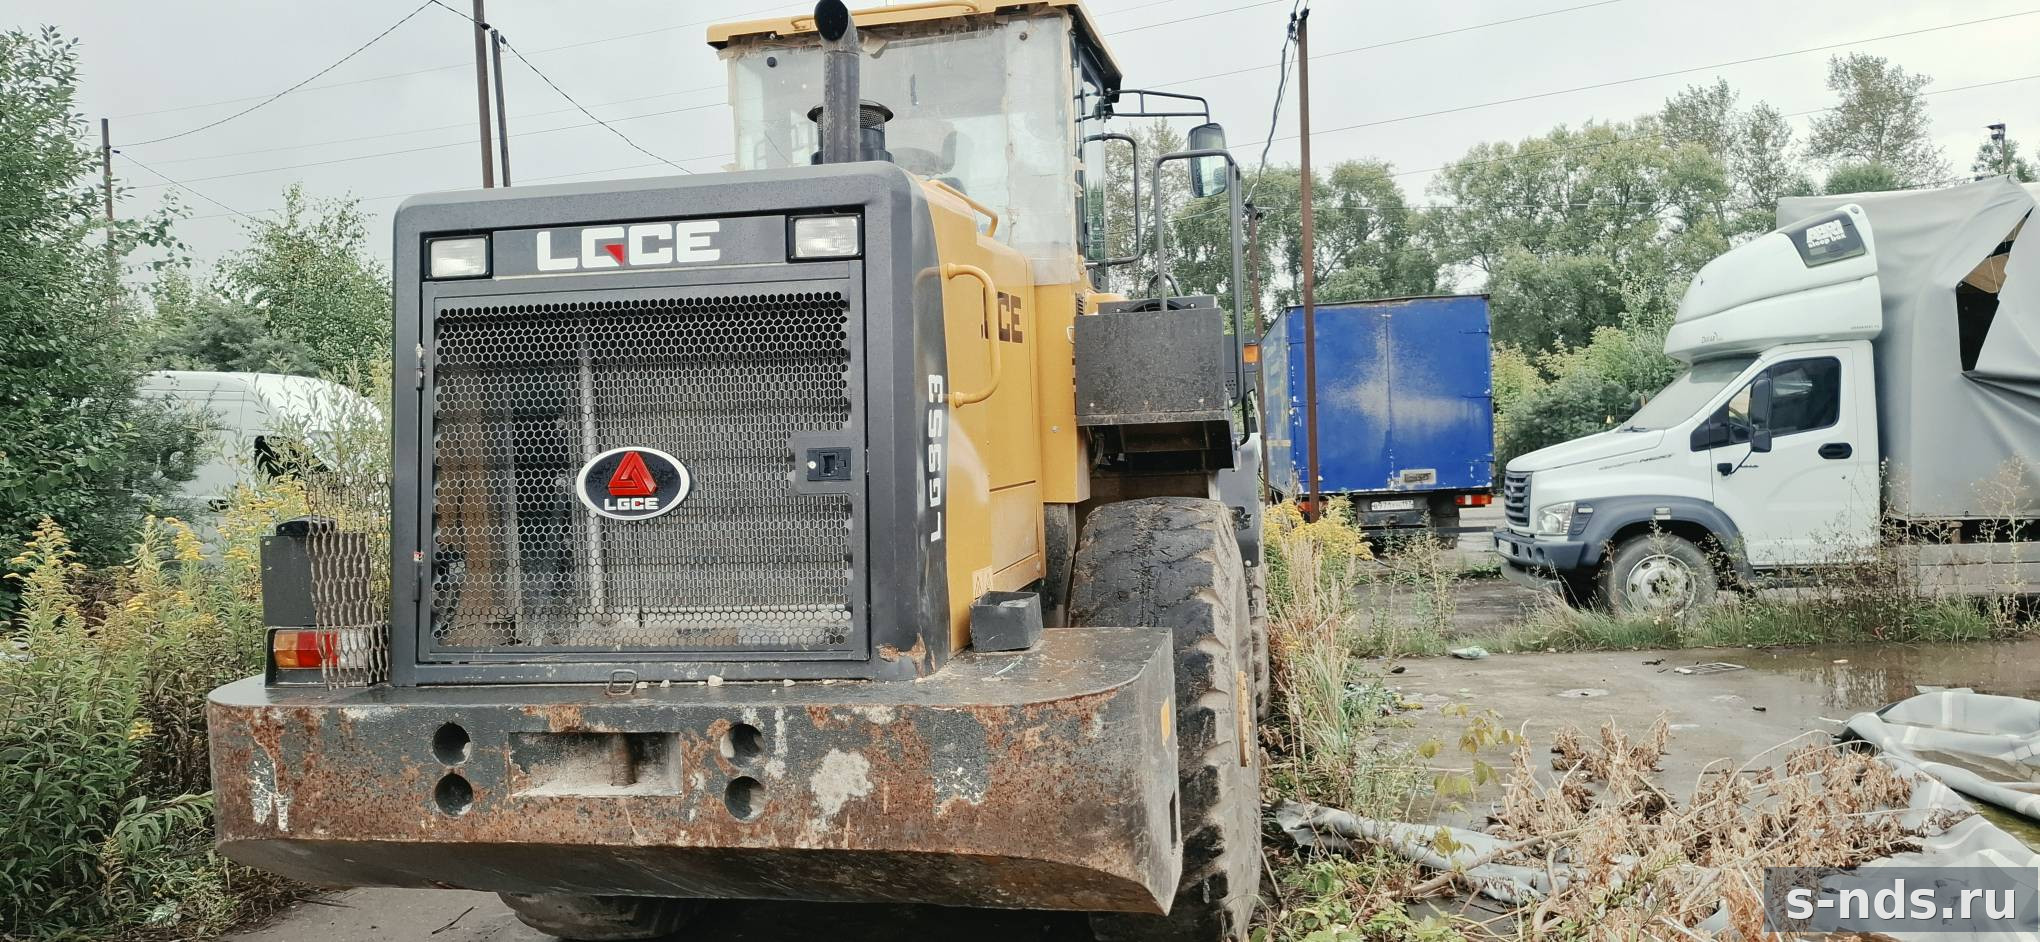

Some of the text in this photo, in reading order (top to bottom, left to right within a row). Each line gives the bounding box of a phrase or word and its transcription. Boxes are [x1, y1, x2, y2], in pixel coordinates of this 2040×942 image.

[536, 220, 720, 272] LGCE
[981, 290, 1023, 344] CE
[928, 374, 944, 543] LG953
[604, 497, 660, 511] LGCE
